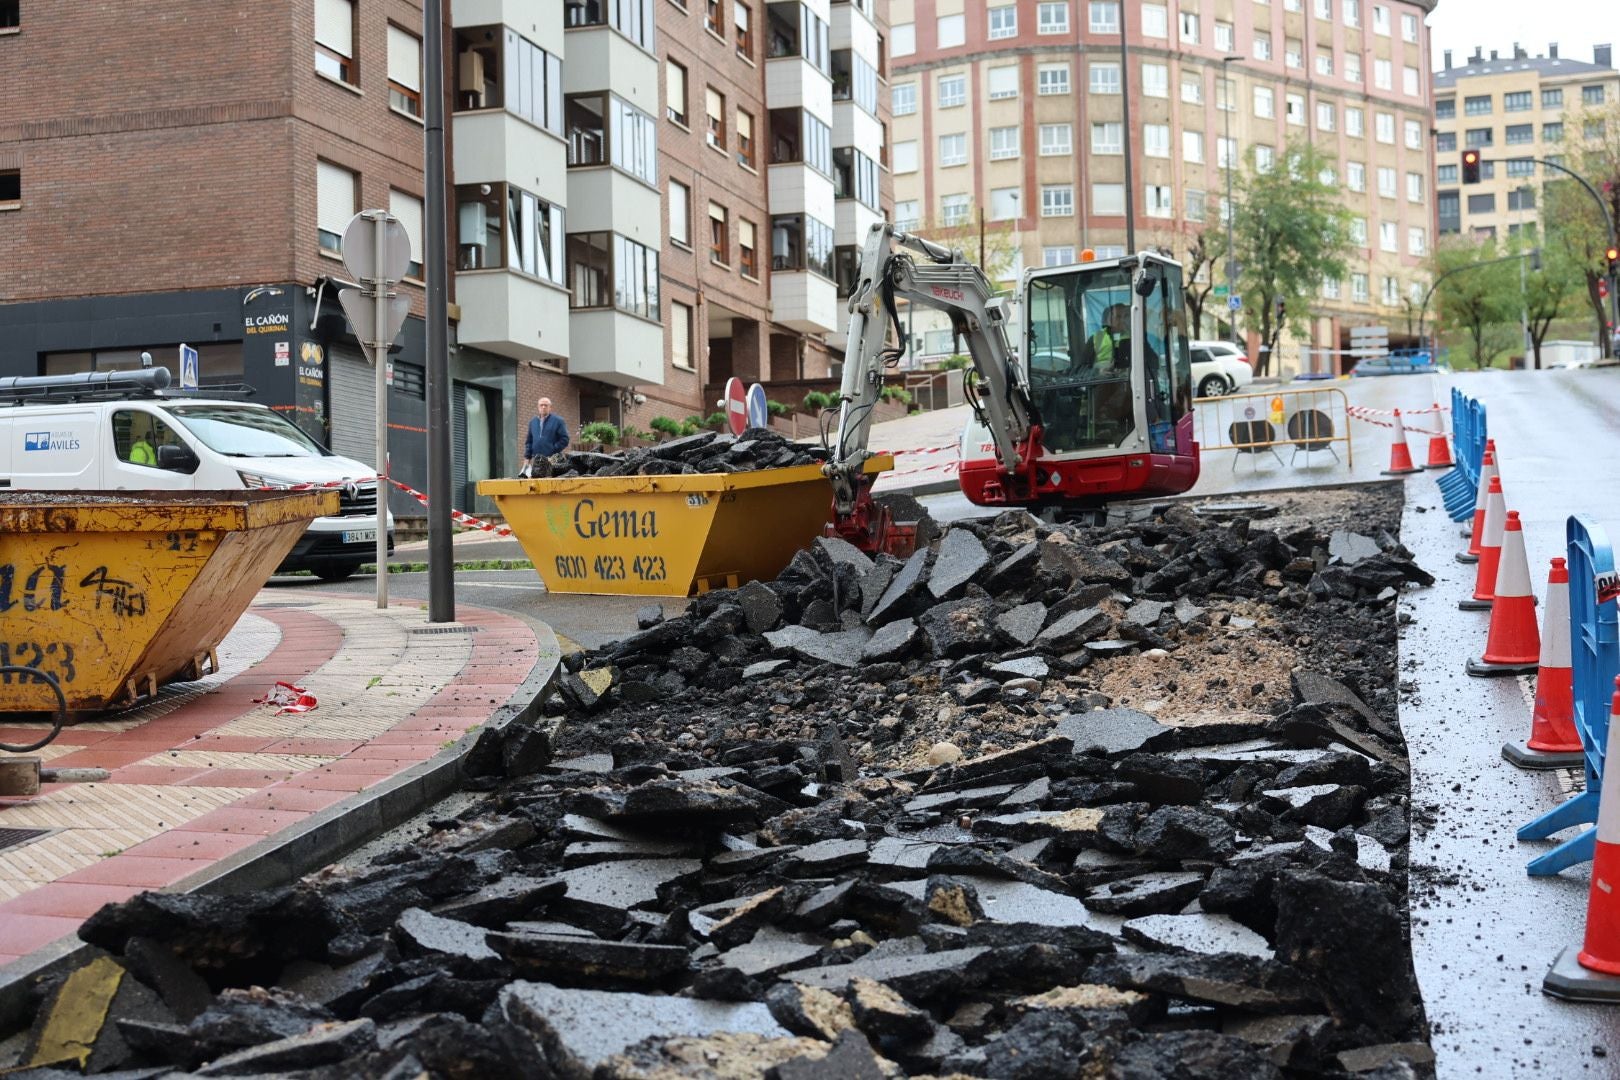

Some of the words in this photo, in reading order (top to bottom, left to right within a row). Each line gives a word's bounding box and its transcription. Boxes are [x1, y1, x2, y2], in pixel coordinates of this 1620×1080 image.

[245, 317, 255, 326] EL
[256, 314, 289, 326] CAÑÓN
[299, 366, 305, 376] EL
[305, 367, 324, 379] CAÑÓN
[50, 439, 80, 450] AVILES
[574, 499, 659, 539] Gema
[555, 555, 588, 579] 600
[594, 555, 626, 580] 423
[632, 555, 666, 581] 423
